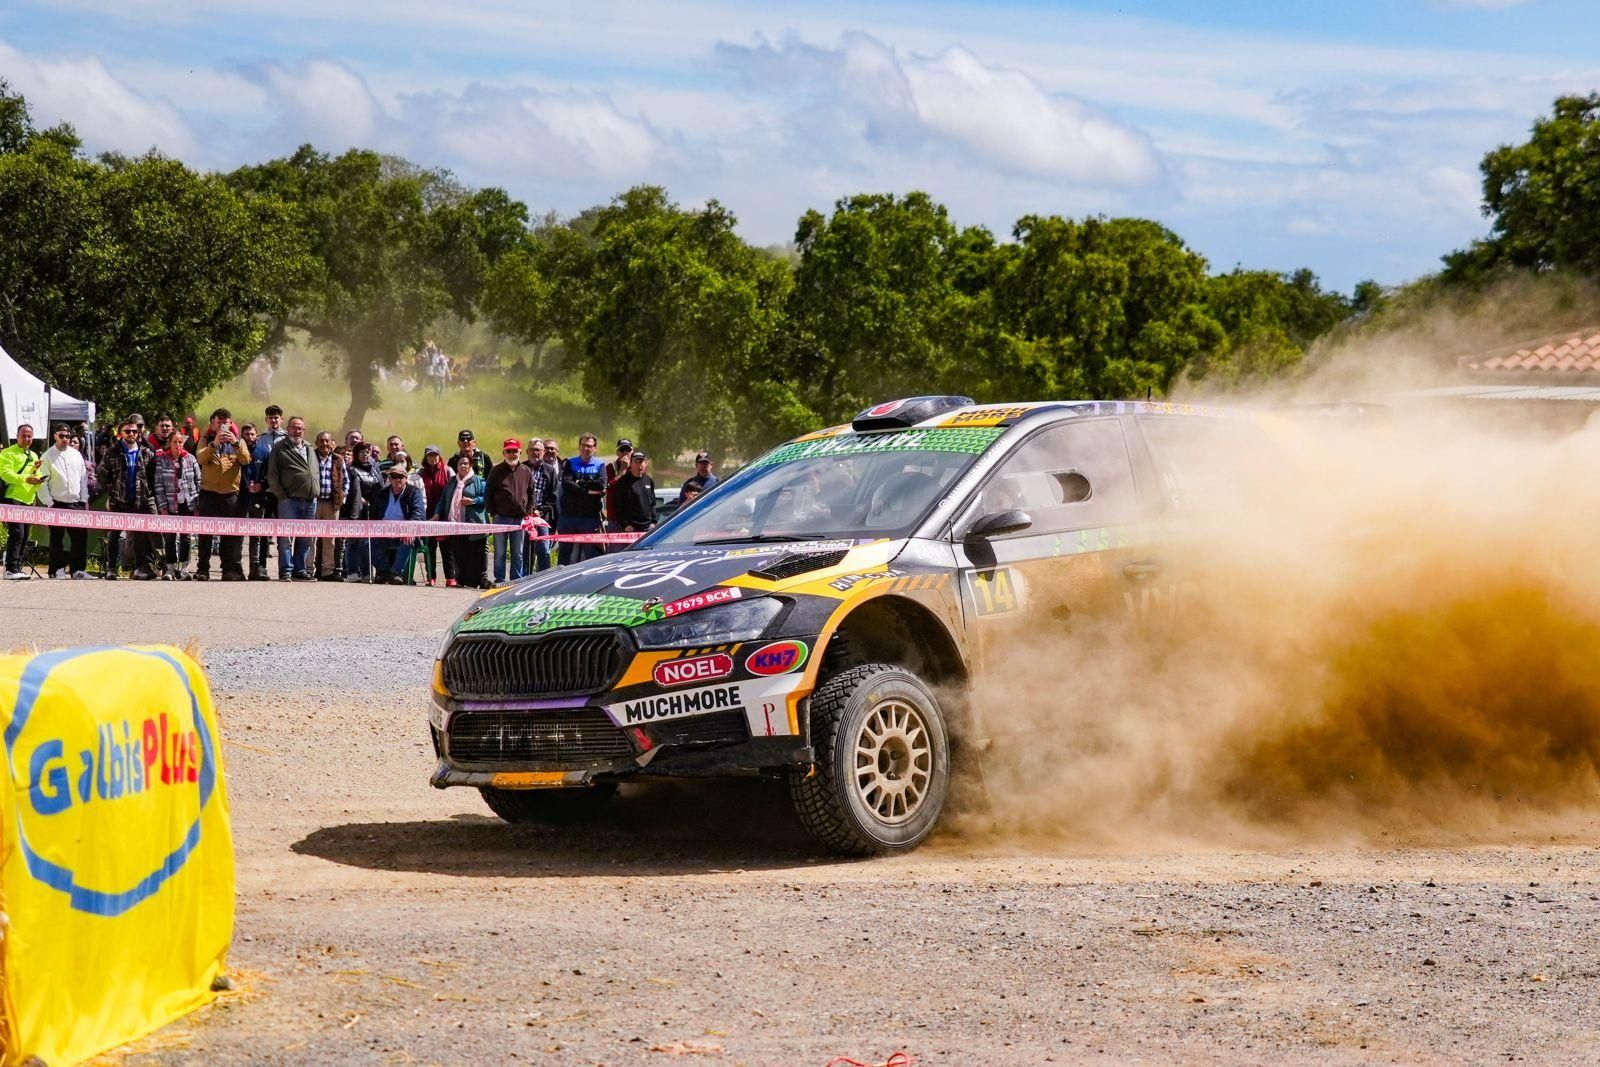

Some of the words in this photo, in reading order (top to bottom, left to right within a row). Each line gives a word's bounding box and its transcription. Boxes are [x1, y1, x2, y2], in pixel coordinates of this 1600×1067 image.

[665, 605, 674, 615] S
[675, 597, 704, 612] 7679
[705, 589, 731, 603] BCK
[975, 571, 1014, 612] 14
[663, 659, 724, 682] NOEL
[625, 685, 742, 723] MUCHMORE
